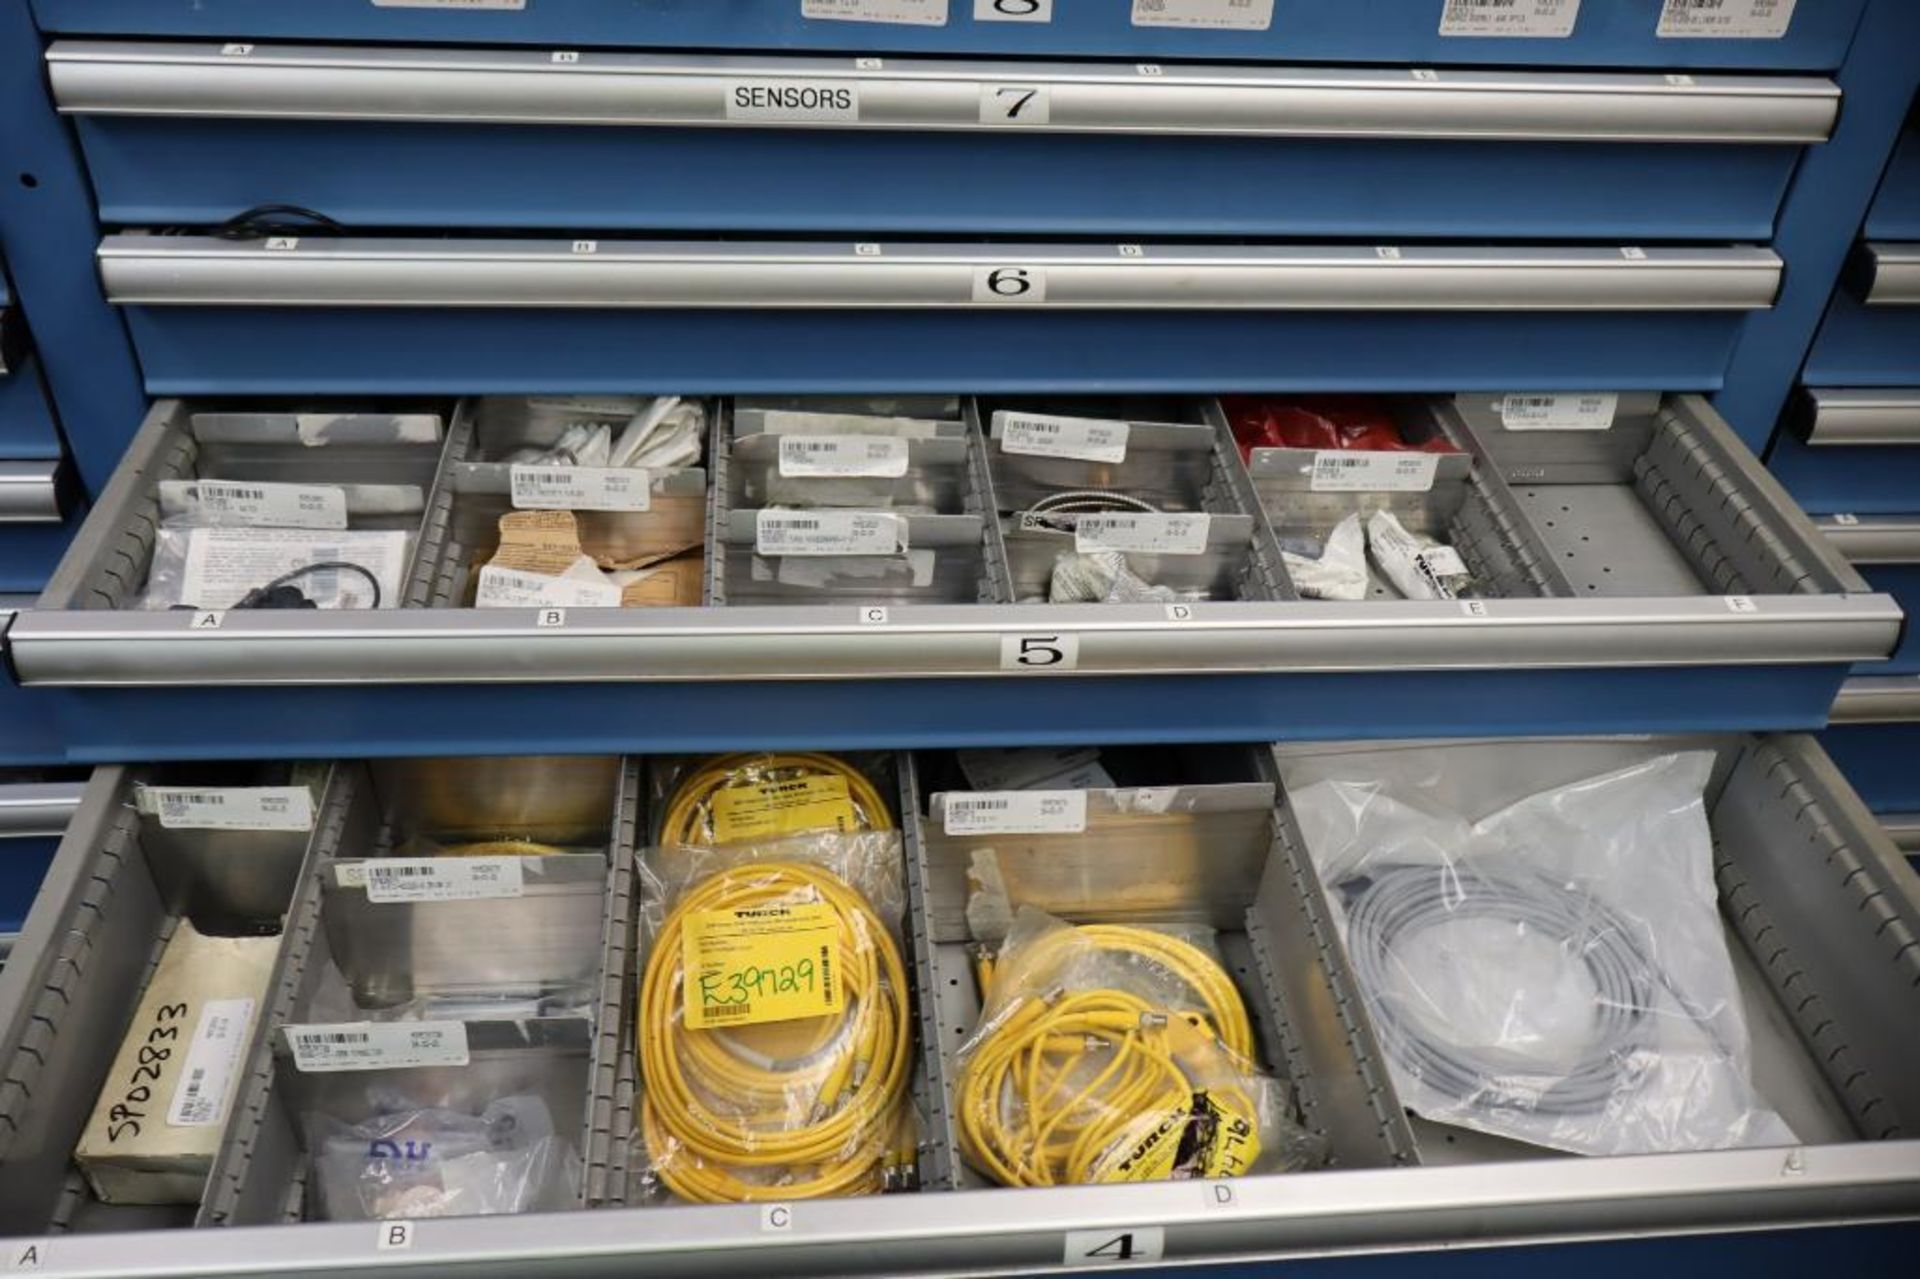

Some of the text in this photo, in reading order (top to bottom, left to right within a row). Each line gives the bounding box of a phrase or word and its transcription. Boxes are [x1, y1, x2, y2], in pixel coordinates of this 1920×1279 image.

[735, 87, 851, 110] SENSORS
[996, 89, 1037, 119] 7
[987, 268, 1030, 296] 6
[546, 611, 561, 624] B
[868, 609, 884, 621] C
[1173, 606, 1189, 618] D
[1469, 601, 1484, 614] E
[200, 613, 217, 625] A
[1016, 635, 1064, 666] 5
[108, 1002, 188, 1143] SP02833
[1214, 1184, 1233, 1204] D
[769, 1207, 789, 1228] C
[388, 1225, 407, 1245] B
[19, 1245, 38, 1265] A
[1085, 1233, 1145, 1260] 4
